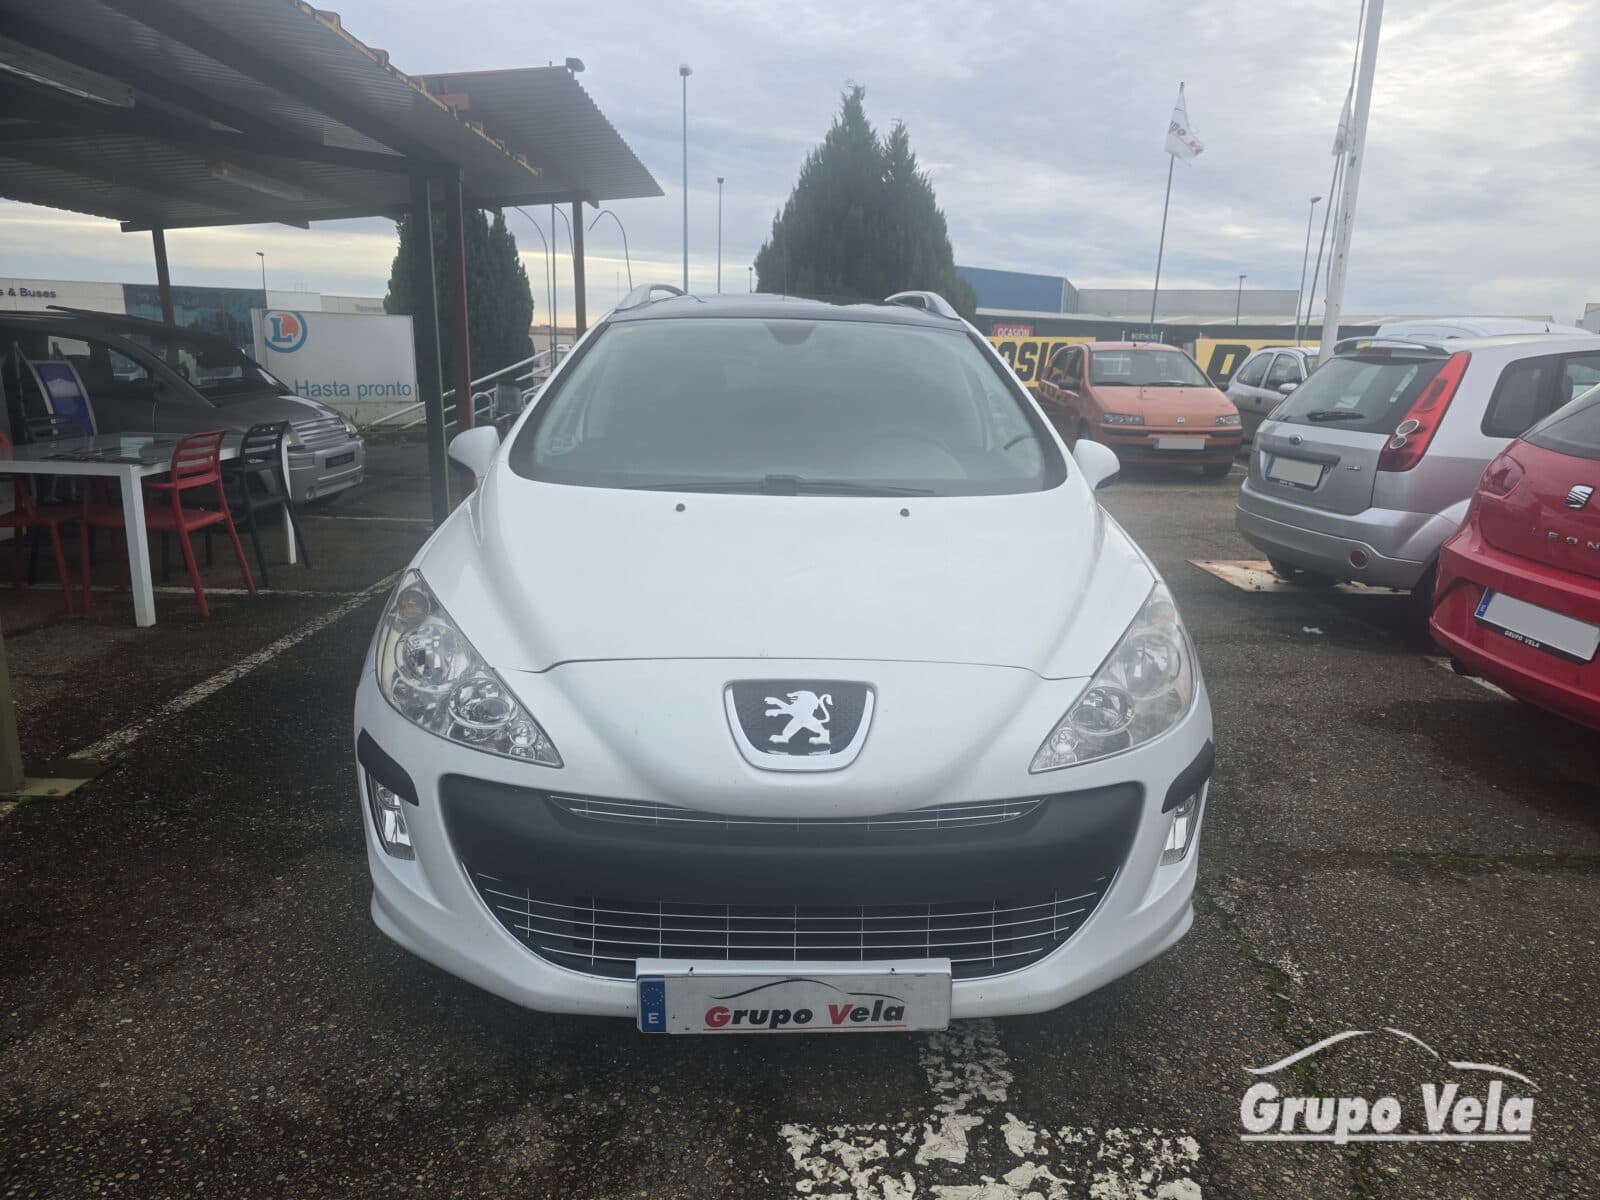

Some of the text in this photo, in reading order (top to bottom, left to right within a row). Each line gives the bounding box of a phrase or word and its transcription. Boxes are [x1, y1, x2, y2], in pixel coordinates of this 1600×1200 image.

[20, 287, 57, 298] Buses
[295, 379, 412, 401] Hasta pronto
[1524, 637, 1541, 649] VELA
[648, 1012, 660, 1024] E
[705, 1000, 906, 1030] Grupo Vela
